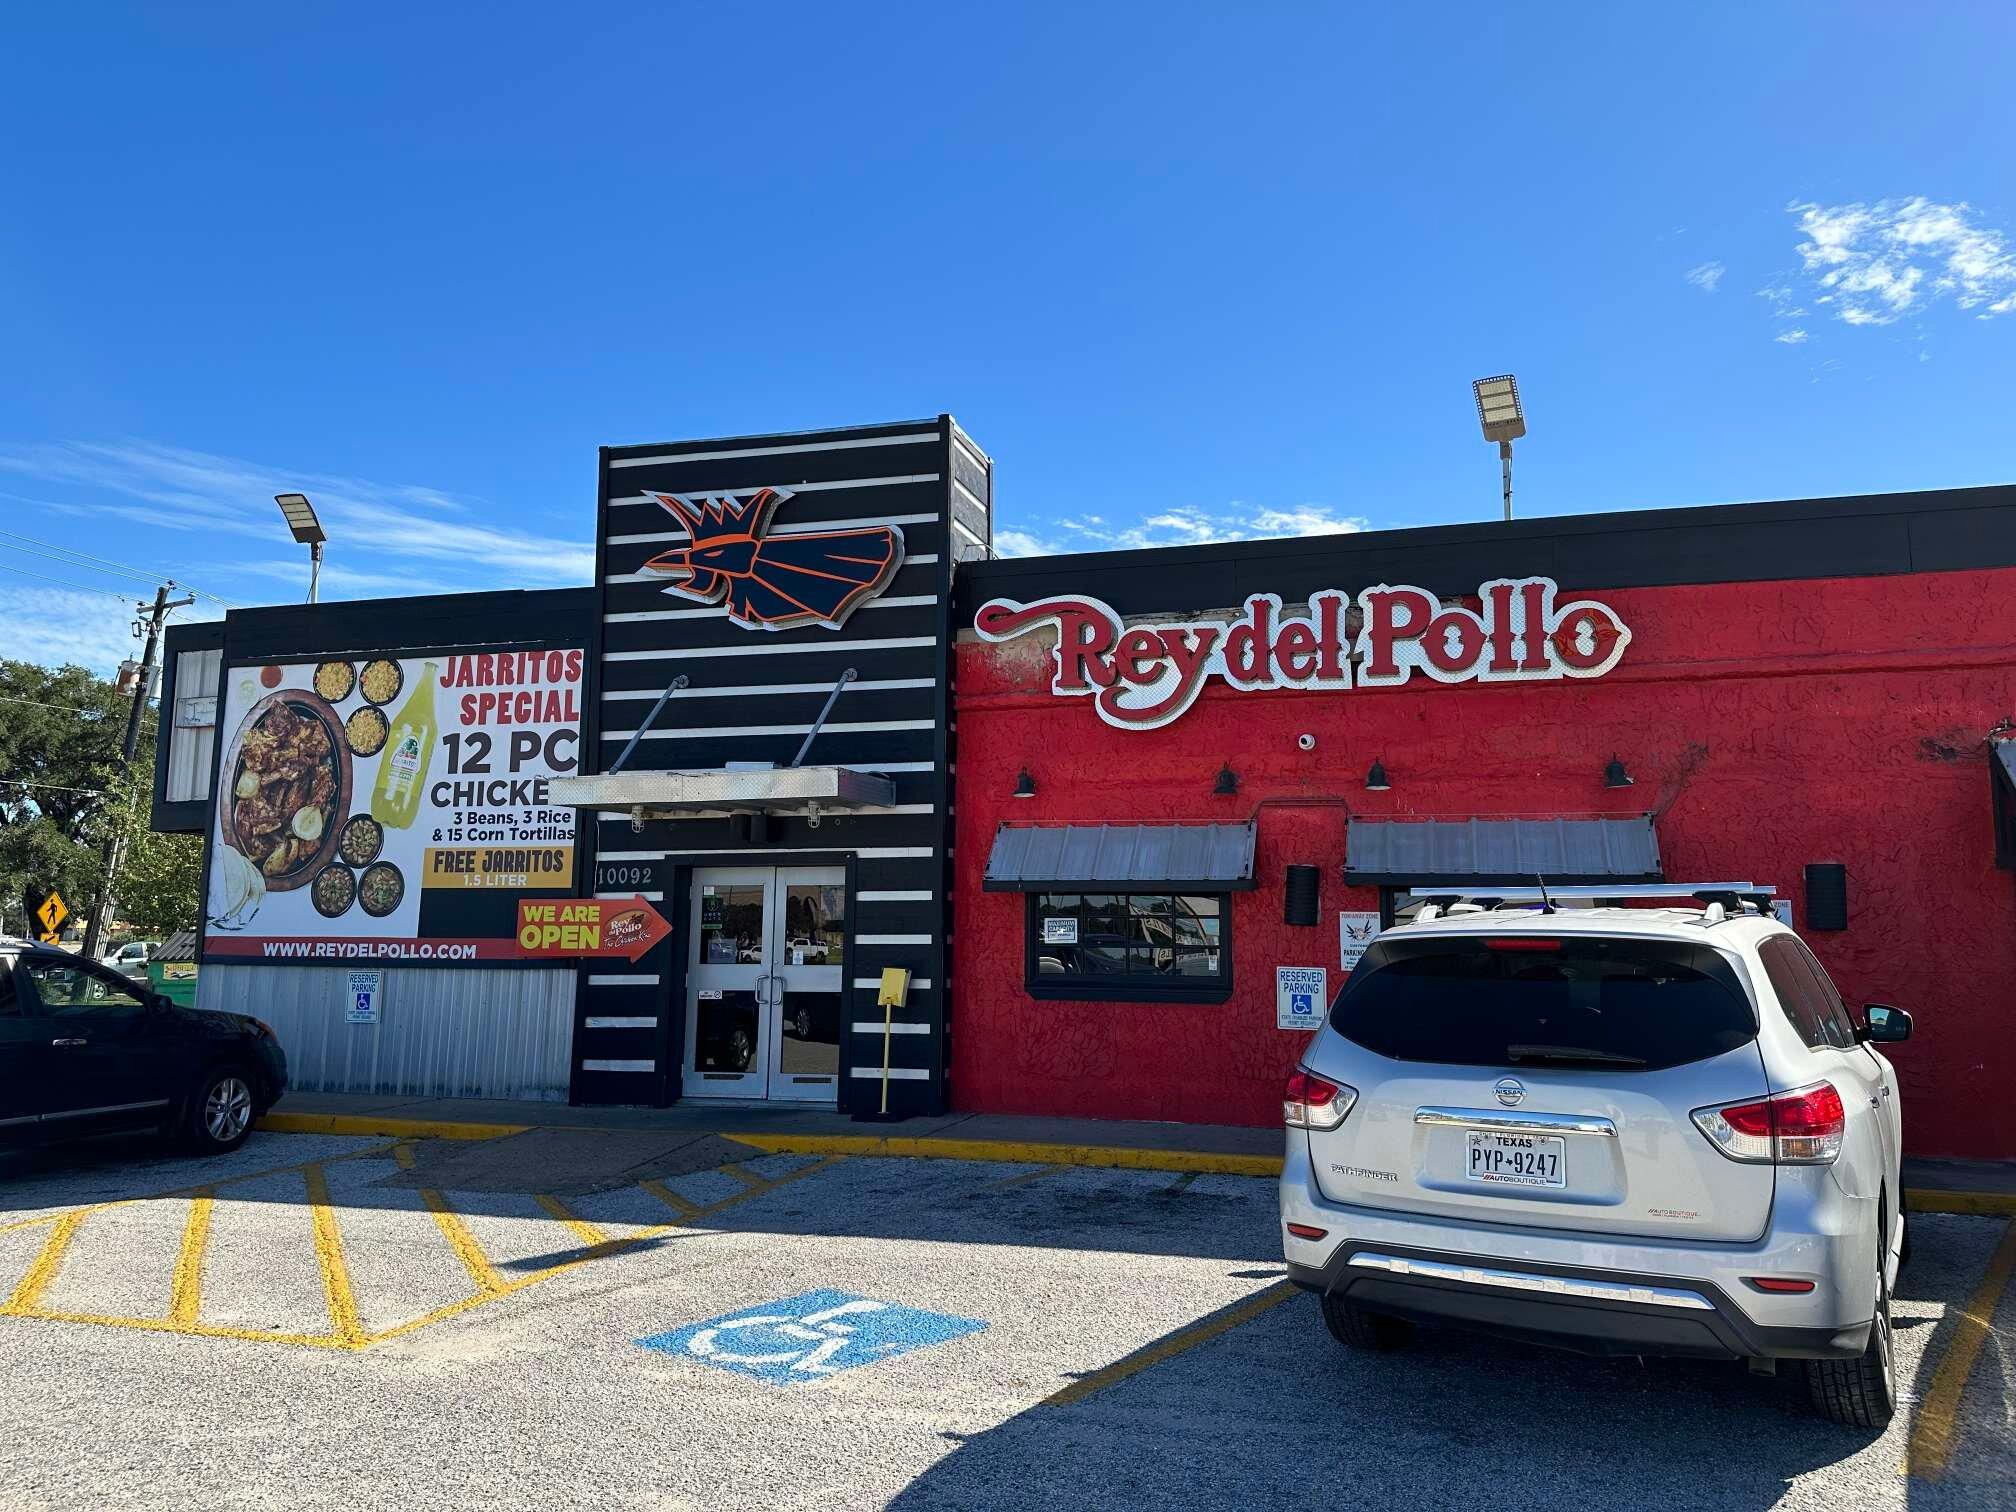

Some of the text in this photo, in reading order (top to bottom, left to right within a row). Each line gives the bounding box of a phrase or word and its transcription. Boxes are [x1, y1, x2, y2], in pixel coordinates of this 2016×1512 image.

[977, 582, 1621, 722] Rey del Pollo
[440, 650, 582, 688] JARRITOS
[460, 689, 579, 725] SPECIAL
[443, 729, 579, 774] 12 PC
[431, 780, 548, 807] CHICKE
[454, 810, 571, 826] 3 Beans, 3 Rice
[432, 826, 576, 841] & 15 Corn Tortillas
[433, 850, 564, 873] FREE JARRITOS
[464, 874, 527, 886] 1.5 LITER
[598, 867, 651, 885] 10092
[523, 905, 600, 923] WE ARE
[520, 925, 600, 949] OPEN
[263, 943, 476, 960] WWW.REYDELPOLLO.COM
[350, 974, 378, 983] RESERVED
[1280, 971, 1322, 983] RESERVED
[352, 983, 376, 993] PARKING
[1283, 982, 1319, 994] PARKING
[1496, 1136, 1533, 1148] TEXAS
[1330, 1163, 1398, 1181] PATHFINDER
